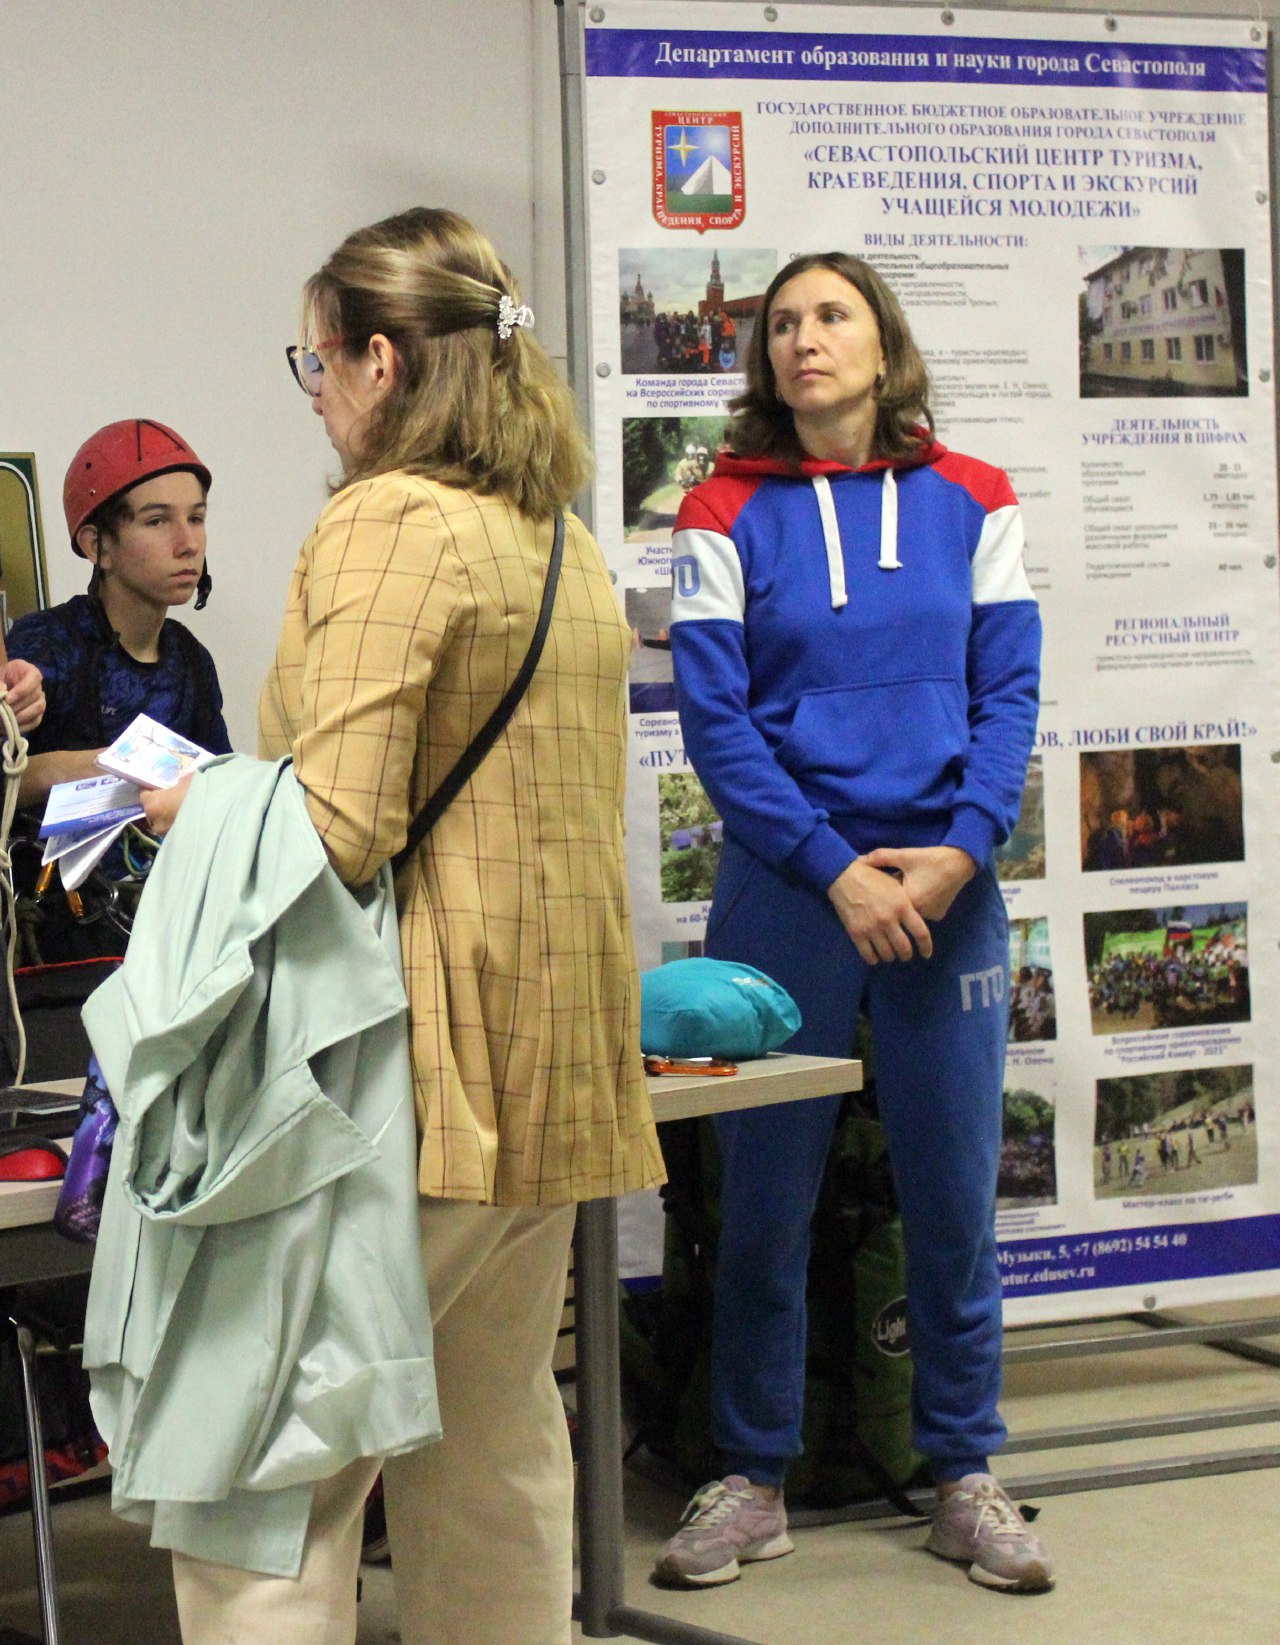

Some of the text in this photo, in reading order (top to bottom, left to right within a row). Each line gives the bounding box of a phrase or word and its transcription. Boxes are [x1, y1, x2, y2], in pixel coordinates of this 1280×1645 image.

[655, 42, 1206, 76] Департамент образования и науки города Севастополя
[678, 116, 714, 125] ЦЕНТР
[757, 101, 1247, 127] ГОСУДАРСТВЕННОЕ БЮДЖЕТНОЕ ОБРАЗОВАТЕЛЬНОЕ УЧРЕЖДЕНИЕ
[790, 121, 1216, 143] ДОПОЛНИТЕЛЬНОГО ОБРАЗОВАНИЯ ГОРОДА СЕВАСТОПОЛЯ
[804, 143, 1203, 170] «СЕВАСТОПОЛЬСКИЙ ЦЕНТР ТУРИЗМА,
[807, 171, 1197, 195] КРАЕВЕДЕНИЯ, СПОРТА И ЭКСКУРСИЙ
[882, 196, 1140, 218] УЧАЩЕЙСЯ МОЛОДЕЖИ»
[864, 233, 1029, 249] ВИДЫ ДЕЯТЕЛЬНОСТИ:
[636, 377, 746, 388] Команда города Севаст
[640, 388, 705, 398] Всероссийских
[660, 400, 719, 408] спортивному
[1111, 418, 1220, 433] ДЕЯТЕЛЬНОСТЬ
[1081, 431, 1249, 446] УЧРЕЖДЕНИЯ В ЦИФРАХ
[638, 556, 671, 566] Южног
[654, 566, 672, 575] «Ш
[1114, 614, 1230, 631] РЕГИОНАЛЬНЫЙ
[1105, 630, 1240, 647] РЕСУРСНЫЙ ЦЕНТР
[639, 718, 679, 727] Соревно
[635, 729, 672, 738] туризму
[1068, 728, 1130, 747] ЛЮБИ
[1135, 721, 1187, 743] СВОЙ
[1192, 718, 1257, 739] КРАЙ!»
[960, 965, 1004, 1011] ГТО
[1073, 1242, 1090, 1255] +7
[1092, 1238, 1132, 1257] (8692)
[1135, 1236, 1151, 1249] 54
[1153, 1234, 1168, 1247] 54
[1171, 1232, 1188, 1246] 40
[1001, 1265, 1095, 1287] utur.edusev.ru
